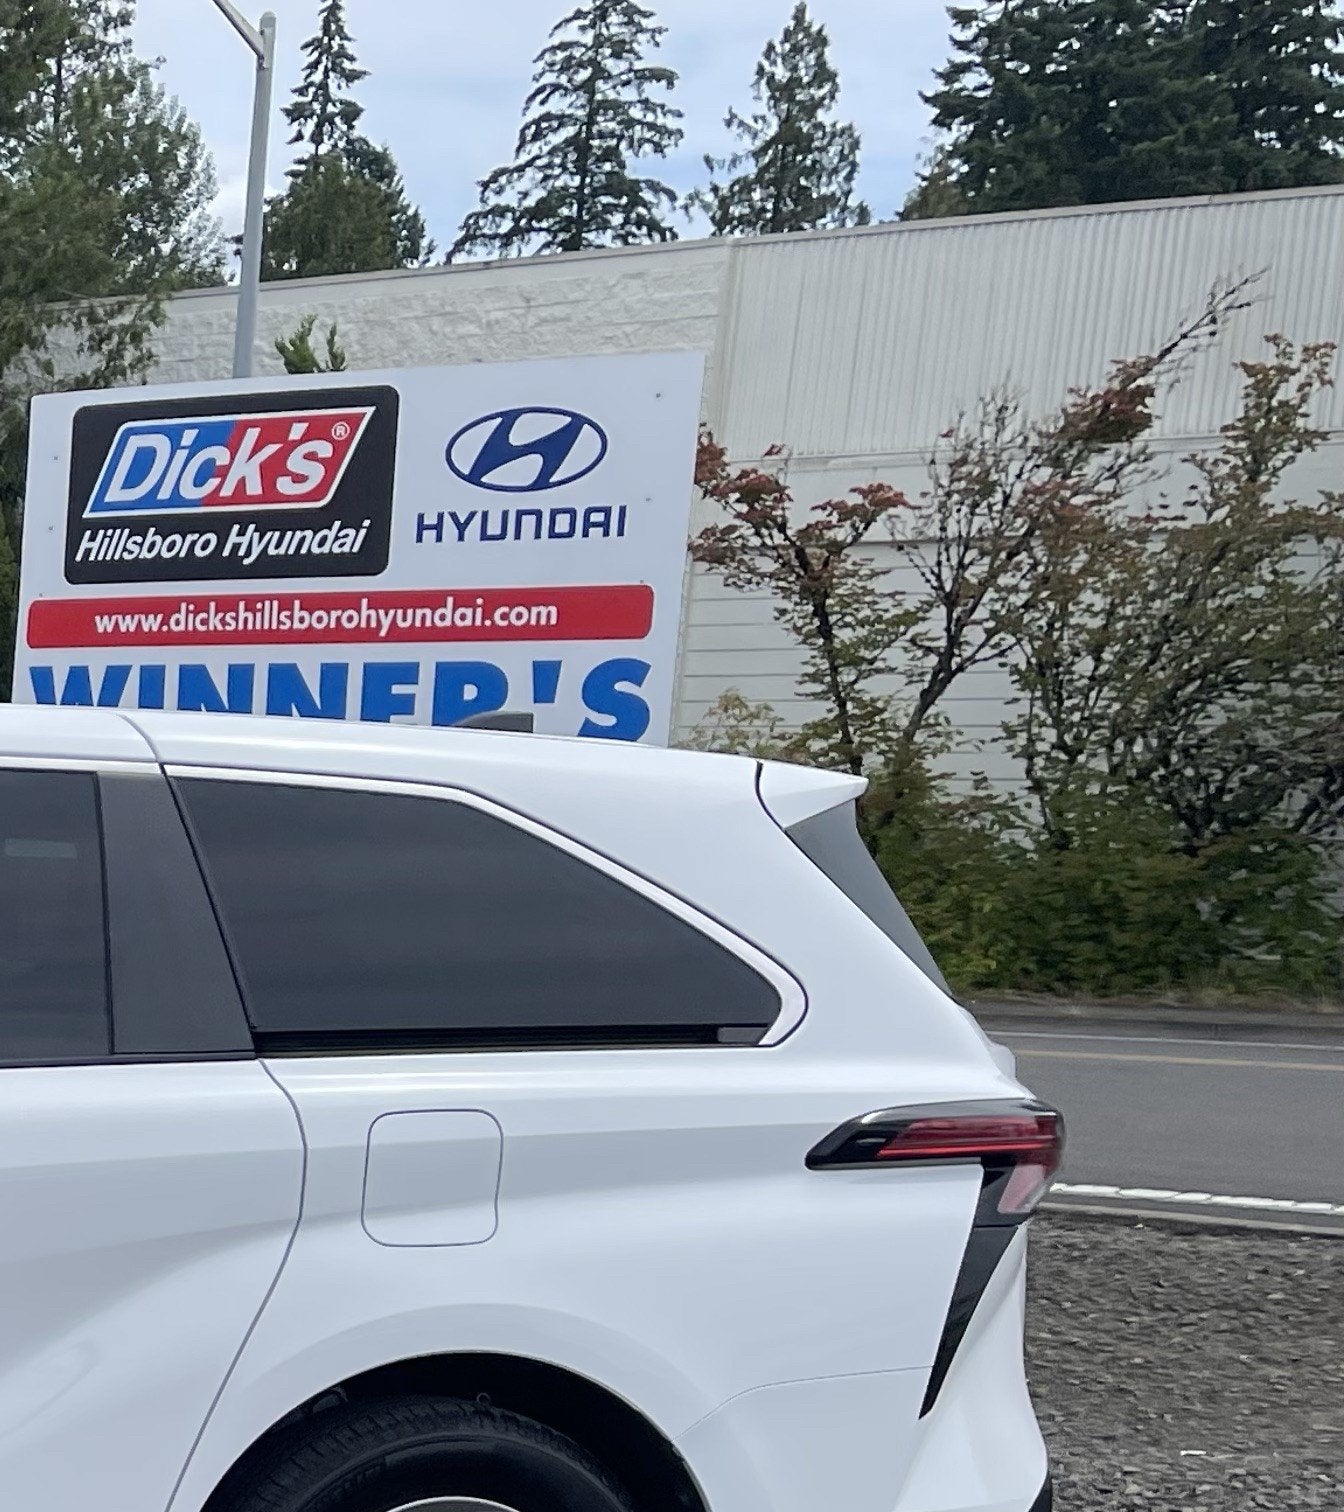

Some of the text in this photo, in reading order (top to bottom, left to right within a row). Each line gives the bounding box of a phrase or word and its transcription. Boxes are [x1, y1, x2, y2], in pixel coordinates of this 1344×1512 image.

[75, 518, 372, 566] Hillsboro Hyundai
[415, 504, 627, 544] HYUNDAI
[94, 596, 559, 637] www.dickshillsborohyundai.com
